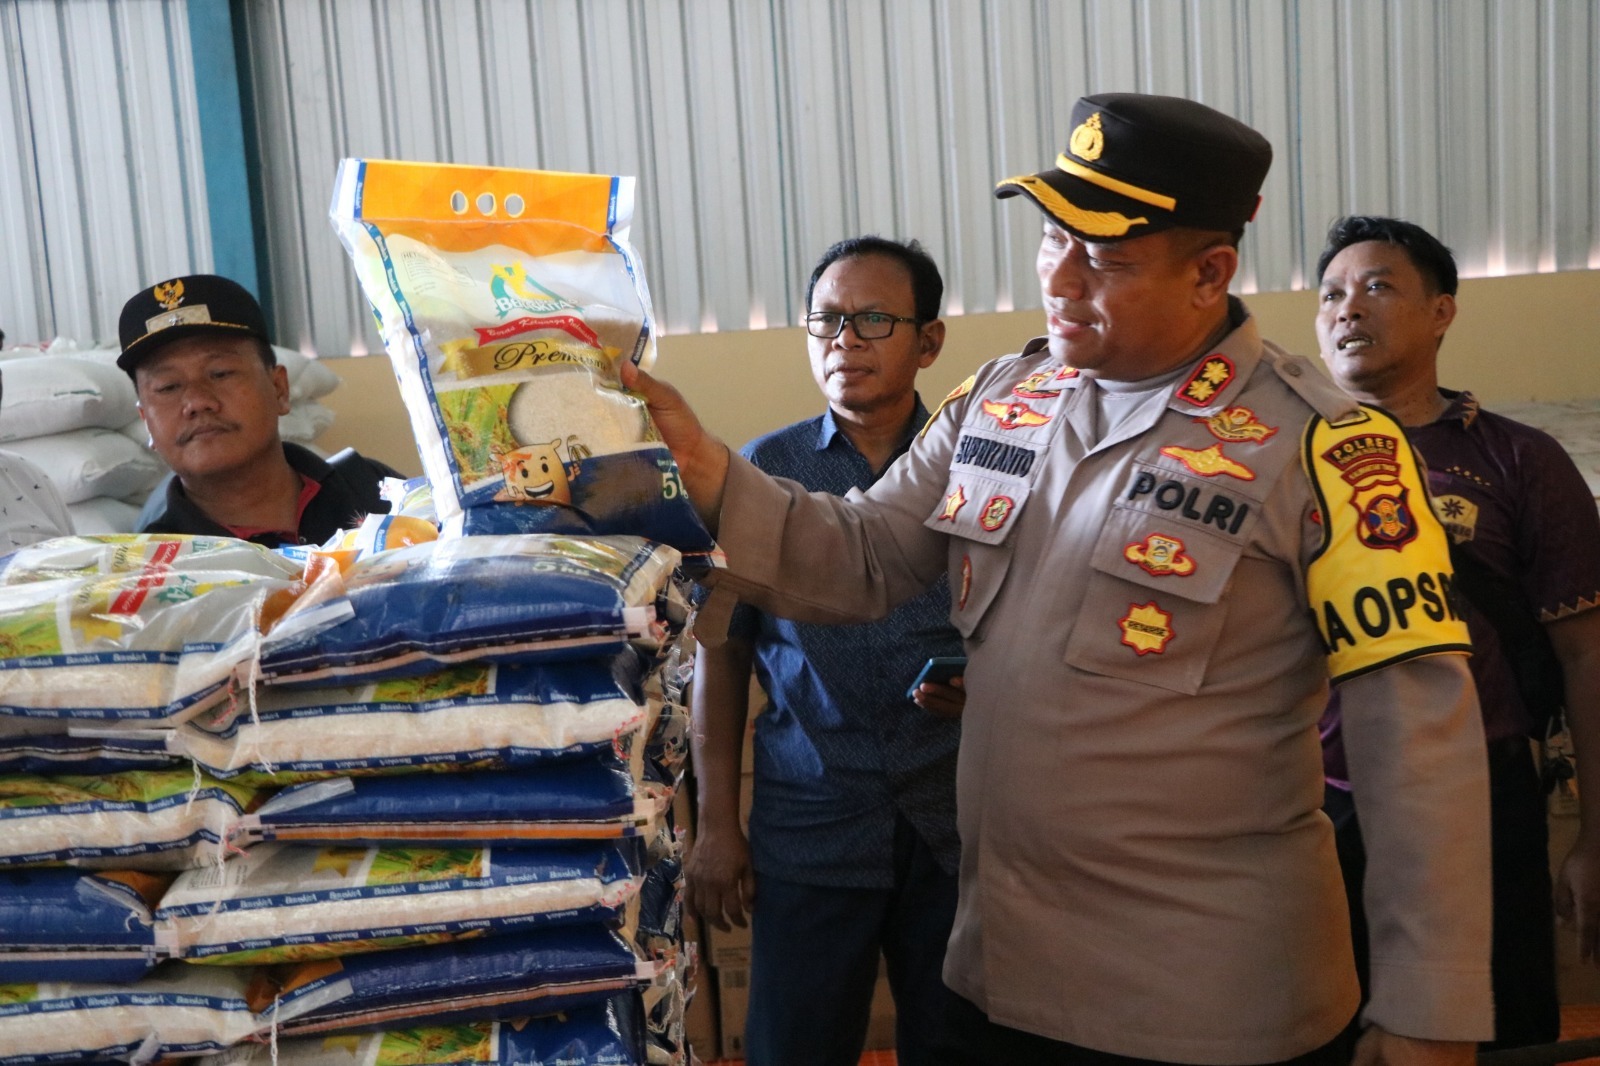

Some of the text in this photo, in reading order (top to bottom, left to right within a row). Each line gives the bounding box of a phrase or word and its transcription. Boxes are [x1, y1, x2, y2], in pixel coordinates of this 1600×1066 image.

[1332, 437, 1395, 460] POLRES
[1127, 471, 1249, 535] POLRI
[1309, 601, 1356, 655] A
